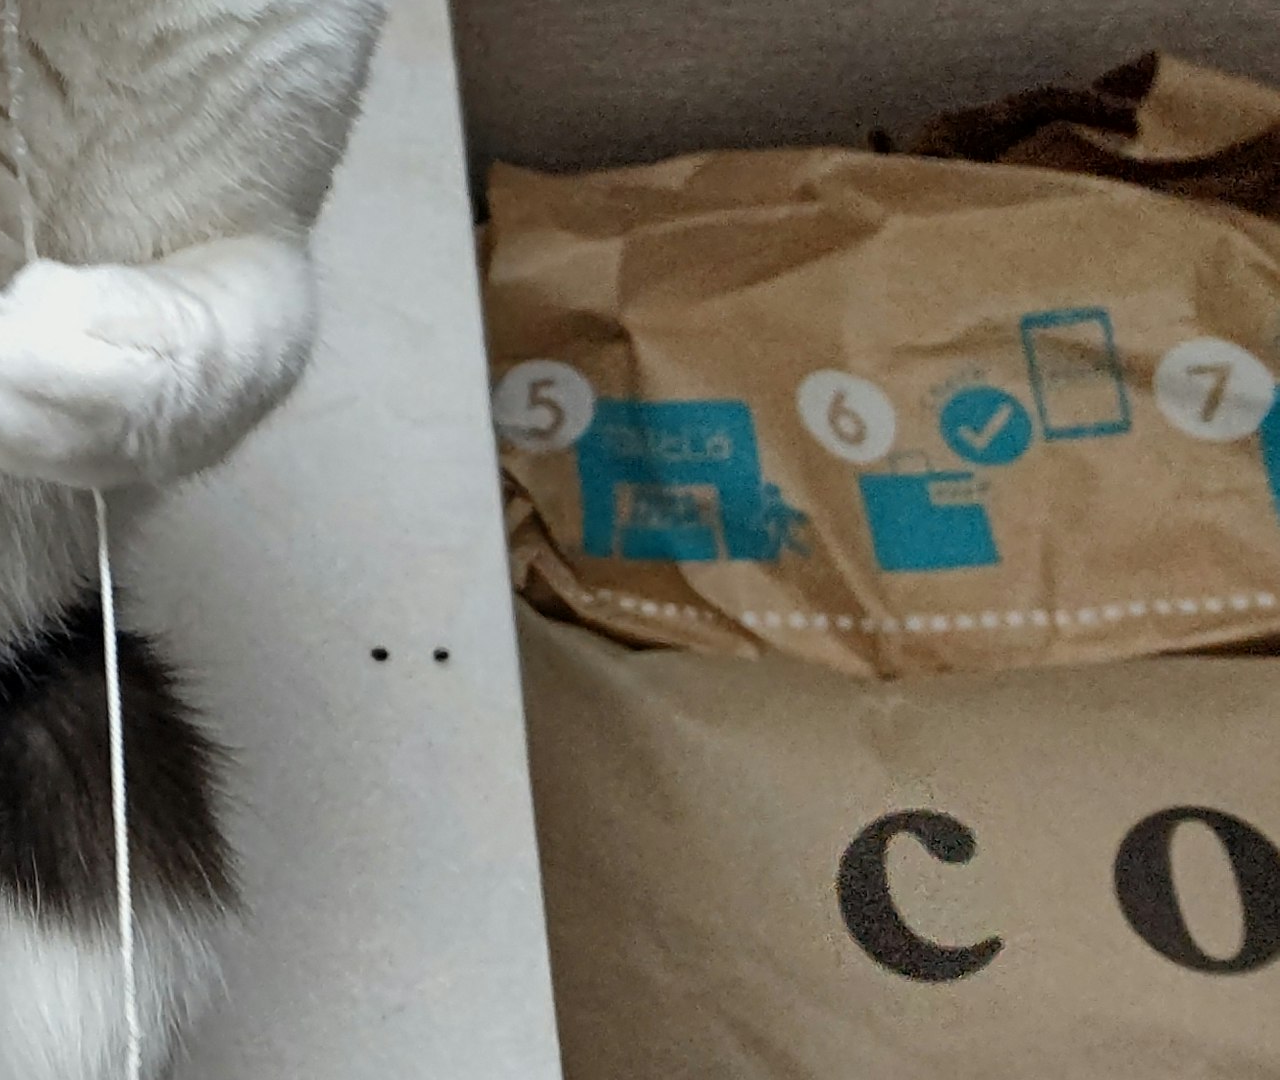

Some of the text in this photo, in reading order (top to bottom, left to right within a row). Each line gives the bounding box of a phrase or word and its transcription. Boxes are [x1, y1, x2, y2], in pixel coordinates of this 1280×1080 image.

[526, 377, 566, 438] 5
[827, 388, 867, 446] 6
[1185, 360, 1233, 423] 7
